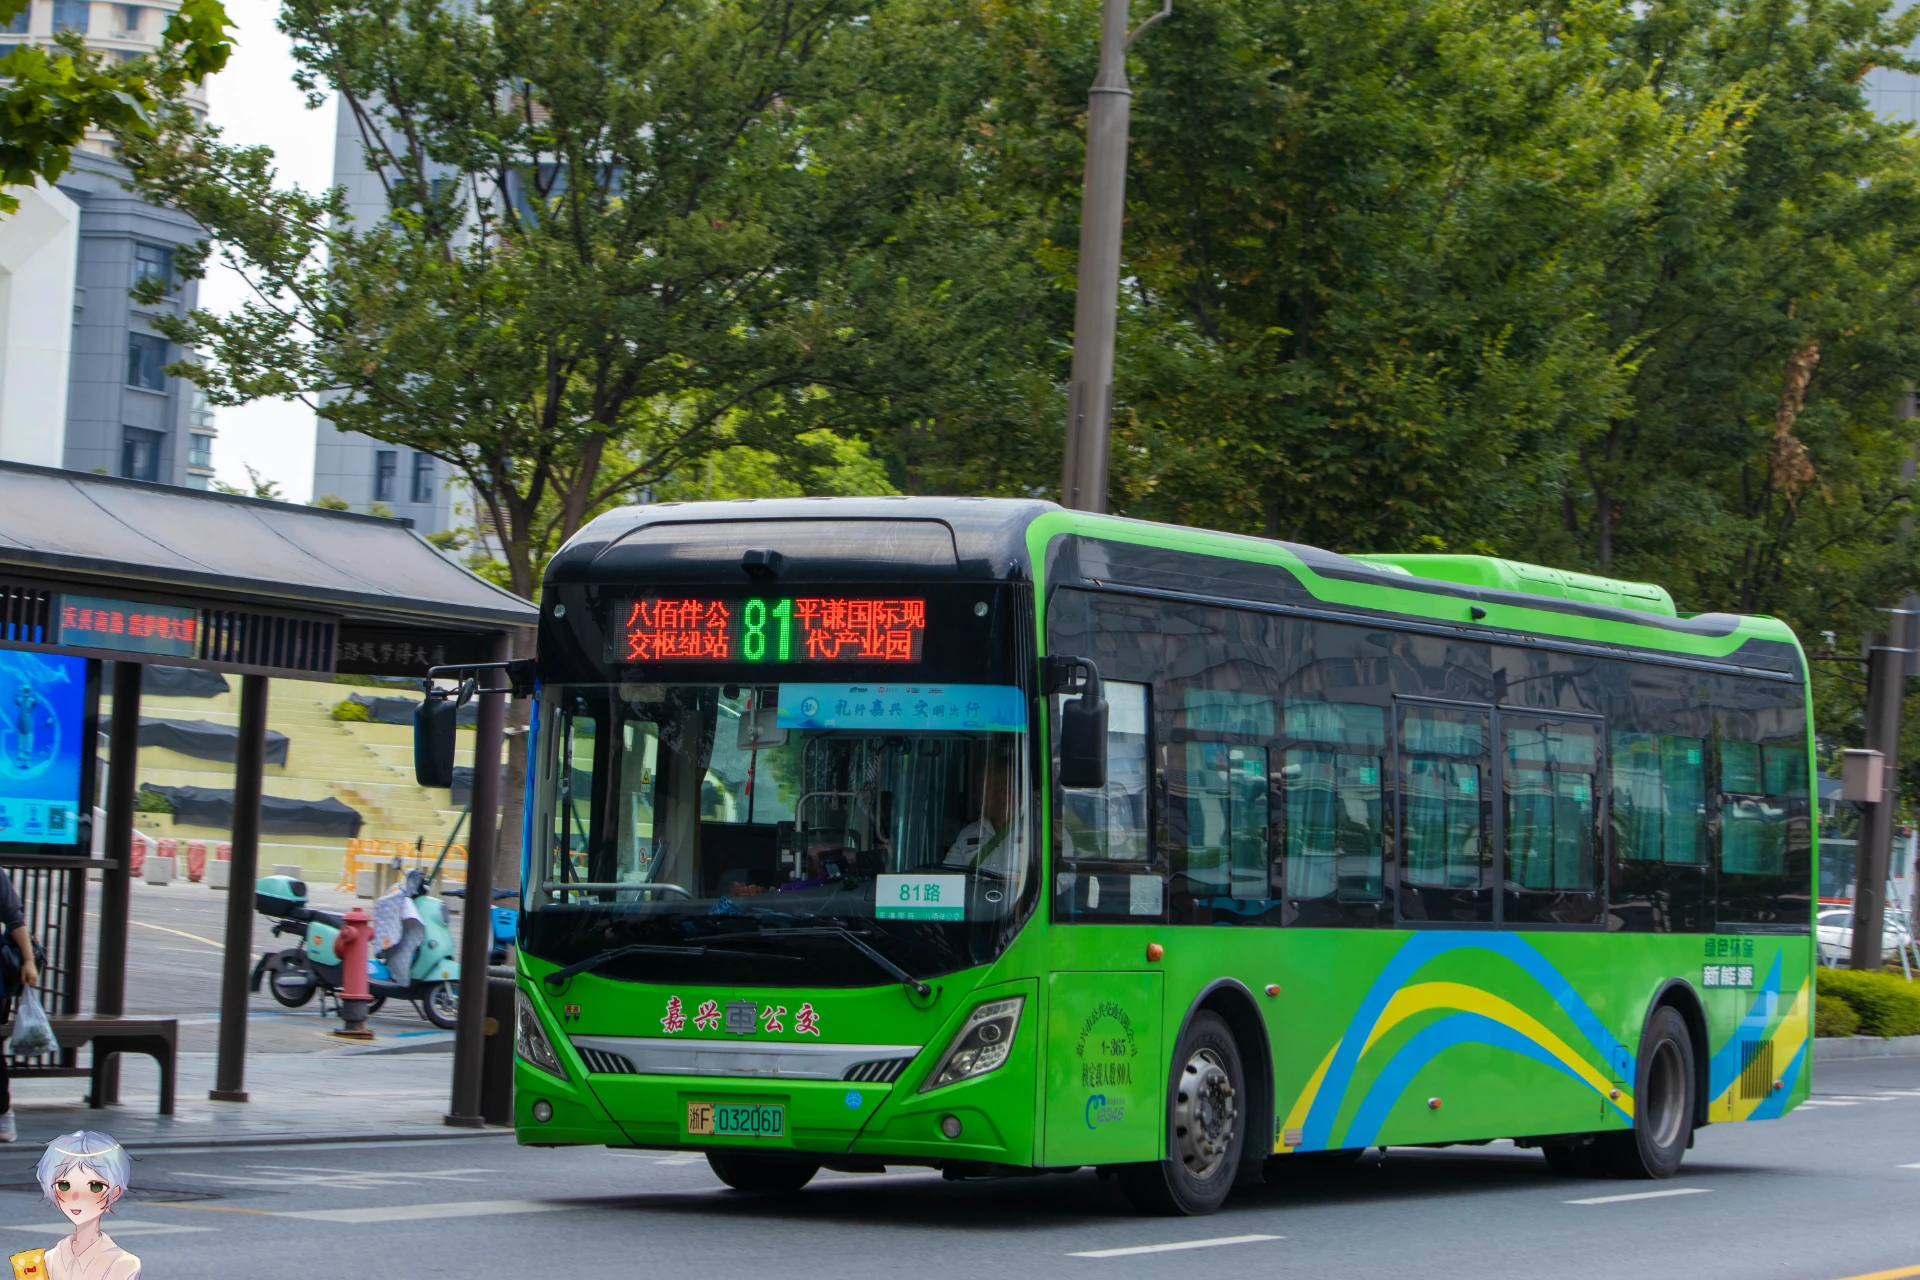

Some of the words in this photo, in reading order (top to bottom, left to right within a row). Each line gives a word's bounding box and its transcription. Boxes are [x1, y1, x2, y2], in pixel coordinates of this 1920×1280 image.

[626, 600, 730, 628] 八佰伴公
[794, 599, 925, 629] 平谦国际现
[626, 629, 730, 660] 交枢纽站
[743, 599, 791, 660] 81
[805, 629, 912, 660] 代产业园
[899, 883, 941, 902] 81路
[1702, 965, 1753, 986] 新能源
